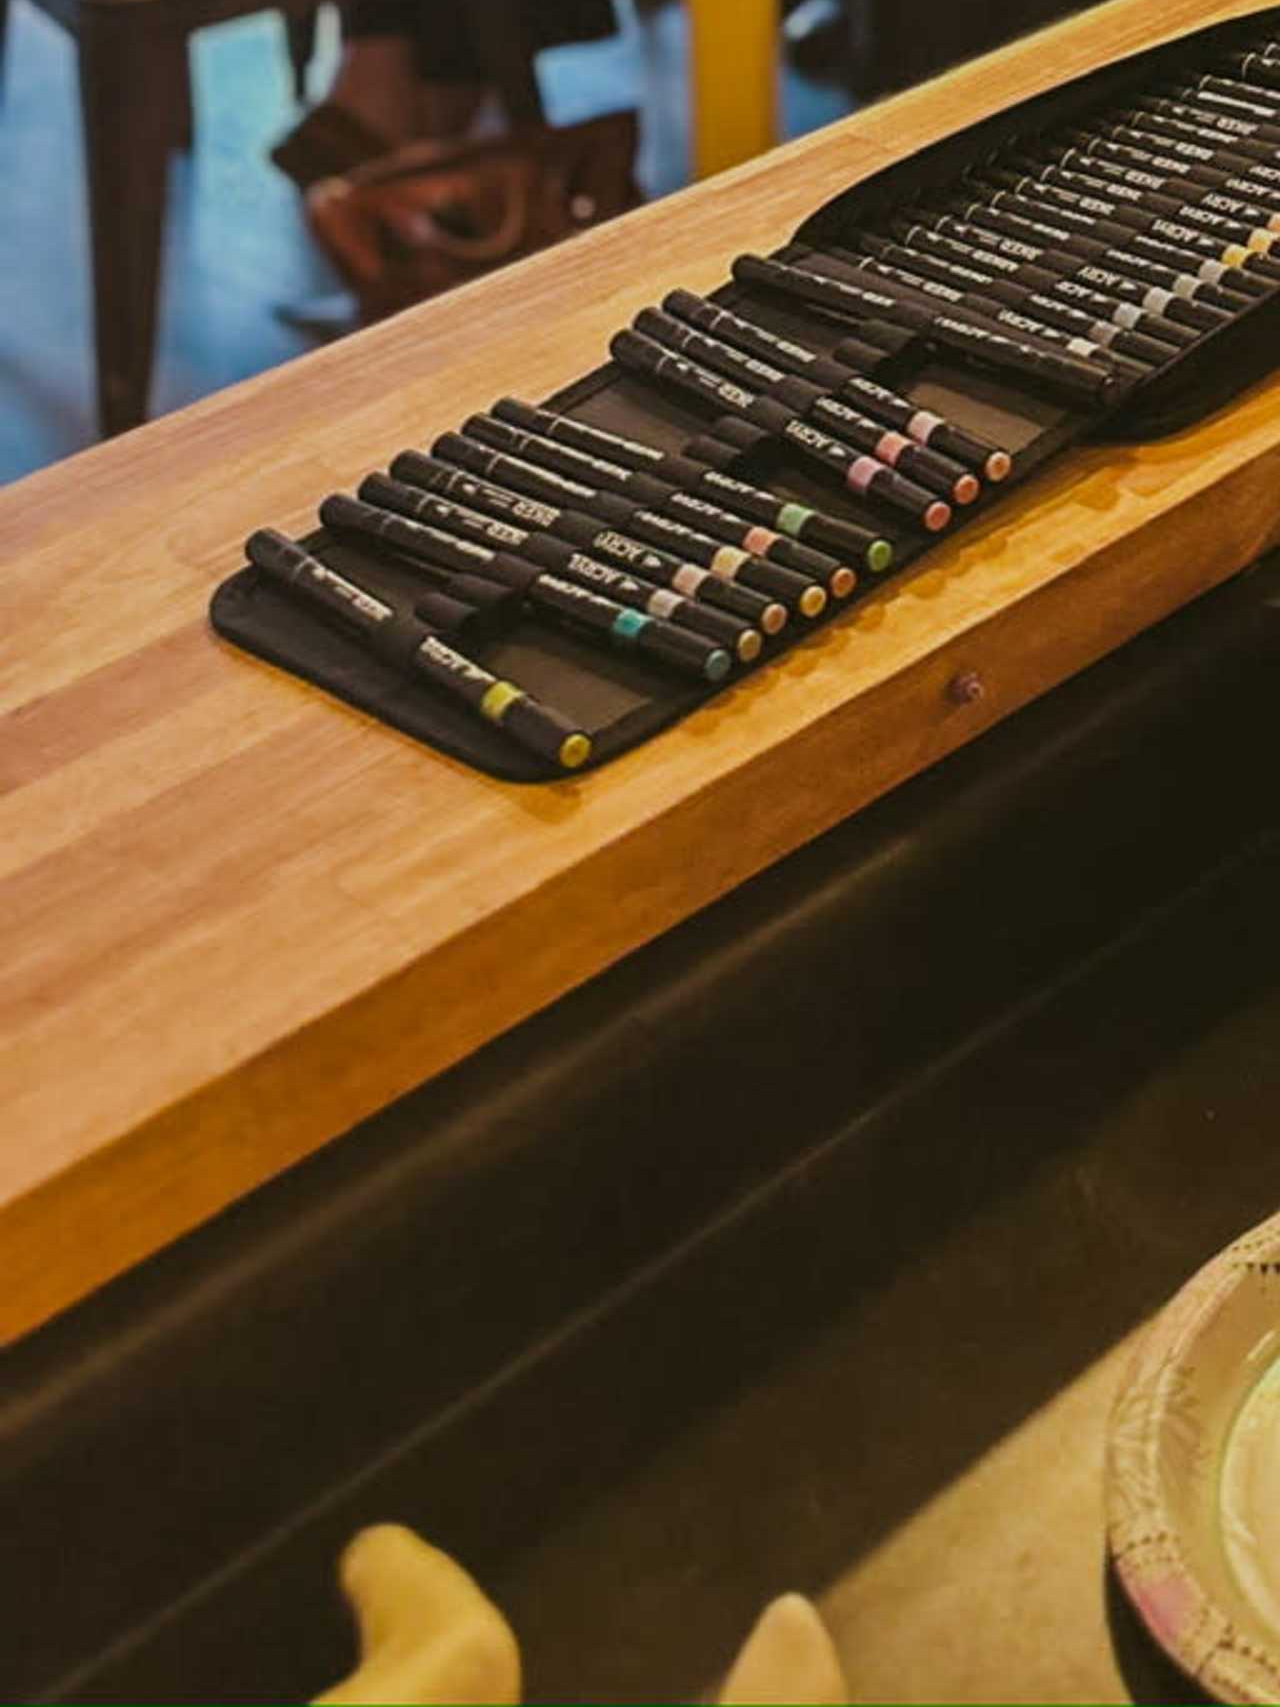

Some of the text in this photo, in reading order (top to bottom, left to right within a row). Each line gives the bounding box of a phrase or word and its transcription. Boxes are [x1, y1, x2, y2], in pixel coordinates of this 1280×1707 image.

[1200, 191, 1245, 214] ACRY
[1076, 266, 1120, 285] ACRY
[566, 551, 620, 584] ACRYL
